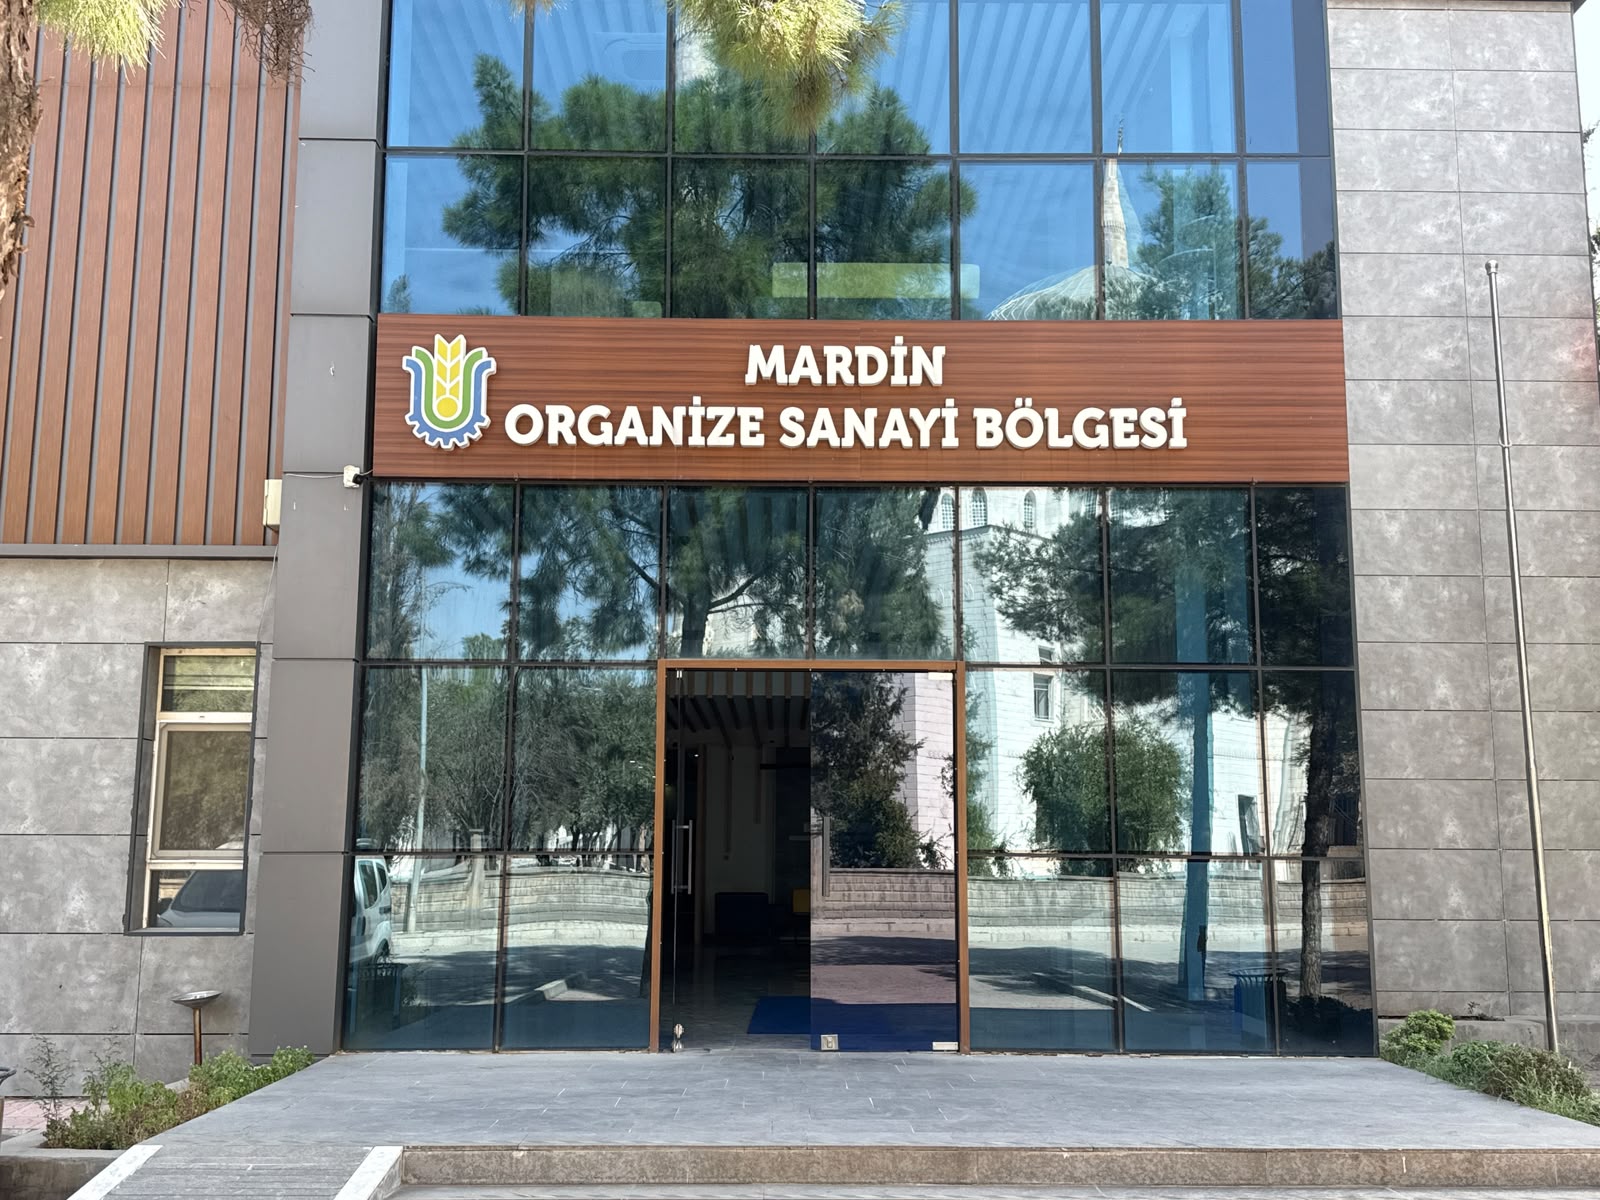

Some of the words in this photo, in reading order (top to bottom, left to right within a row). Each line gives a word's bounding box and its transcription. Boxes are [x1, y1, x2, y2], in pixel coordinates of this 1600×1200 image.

[743, 335, 947, 387] MARDİN
[504, 395, 766, 448] ORGANİZE
[778, 397, 961, 450] SANAYİ
[973, 396, 1189, 450] BÖLGESİ
